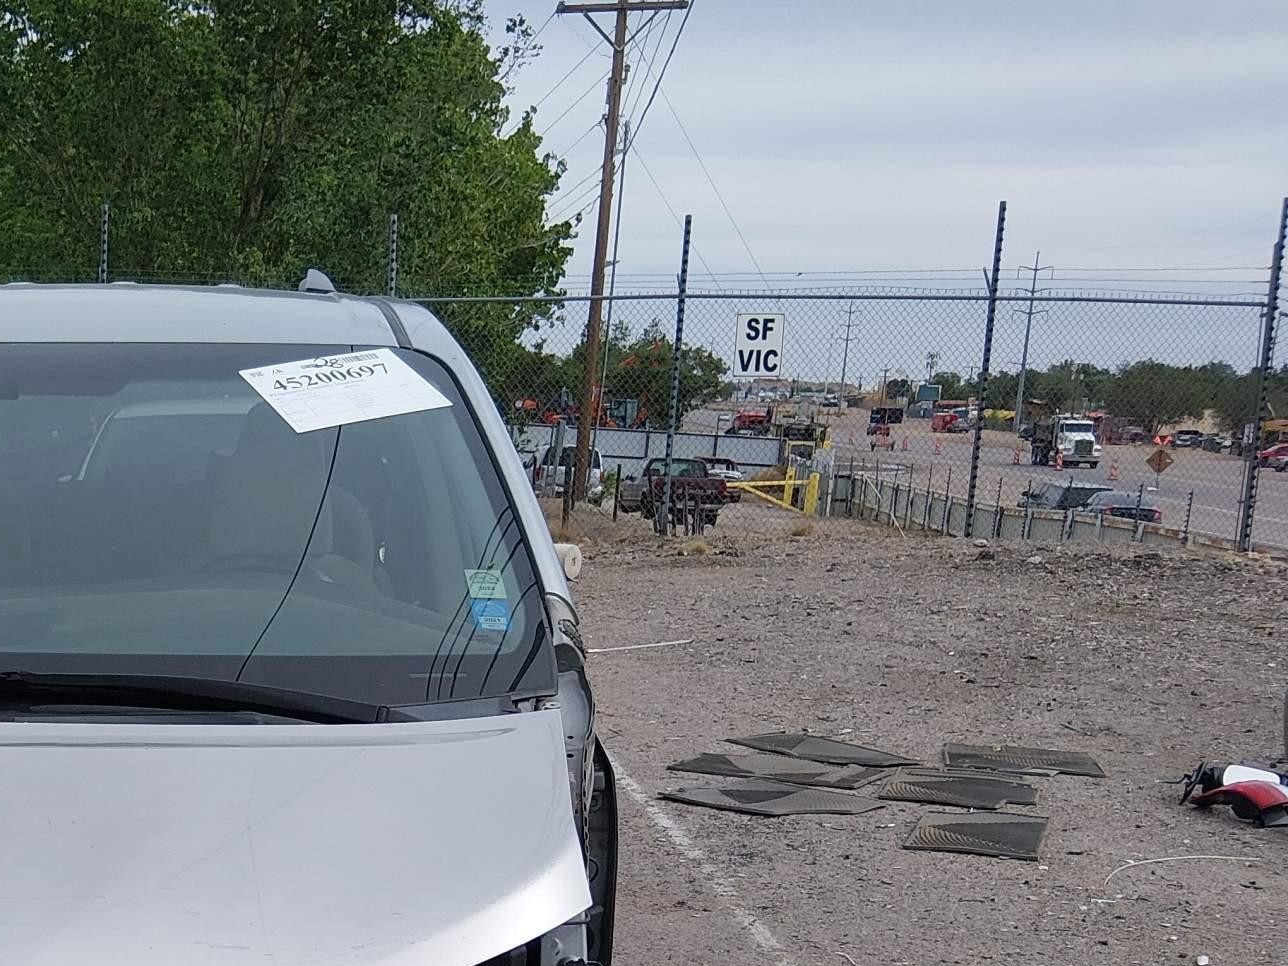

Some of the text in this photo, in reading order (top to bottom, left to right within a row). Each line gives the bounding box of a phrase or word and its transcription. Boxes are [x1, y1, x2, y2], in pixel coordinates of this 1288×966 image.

[745, 317, 776, 341] SF
[737, 349, 779, 373] VIC
[272, 362, 389, 391] 45200697
